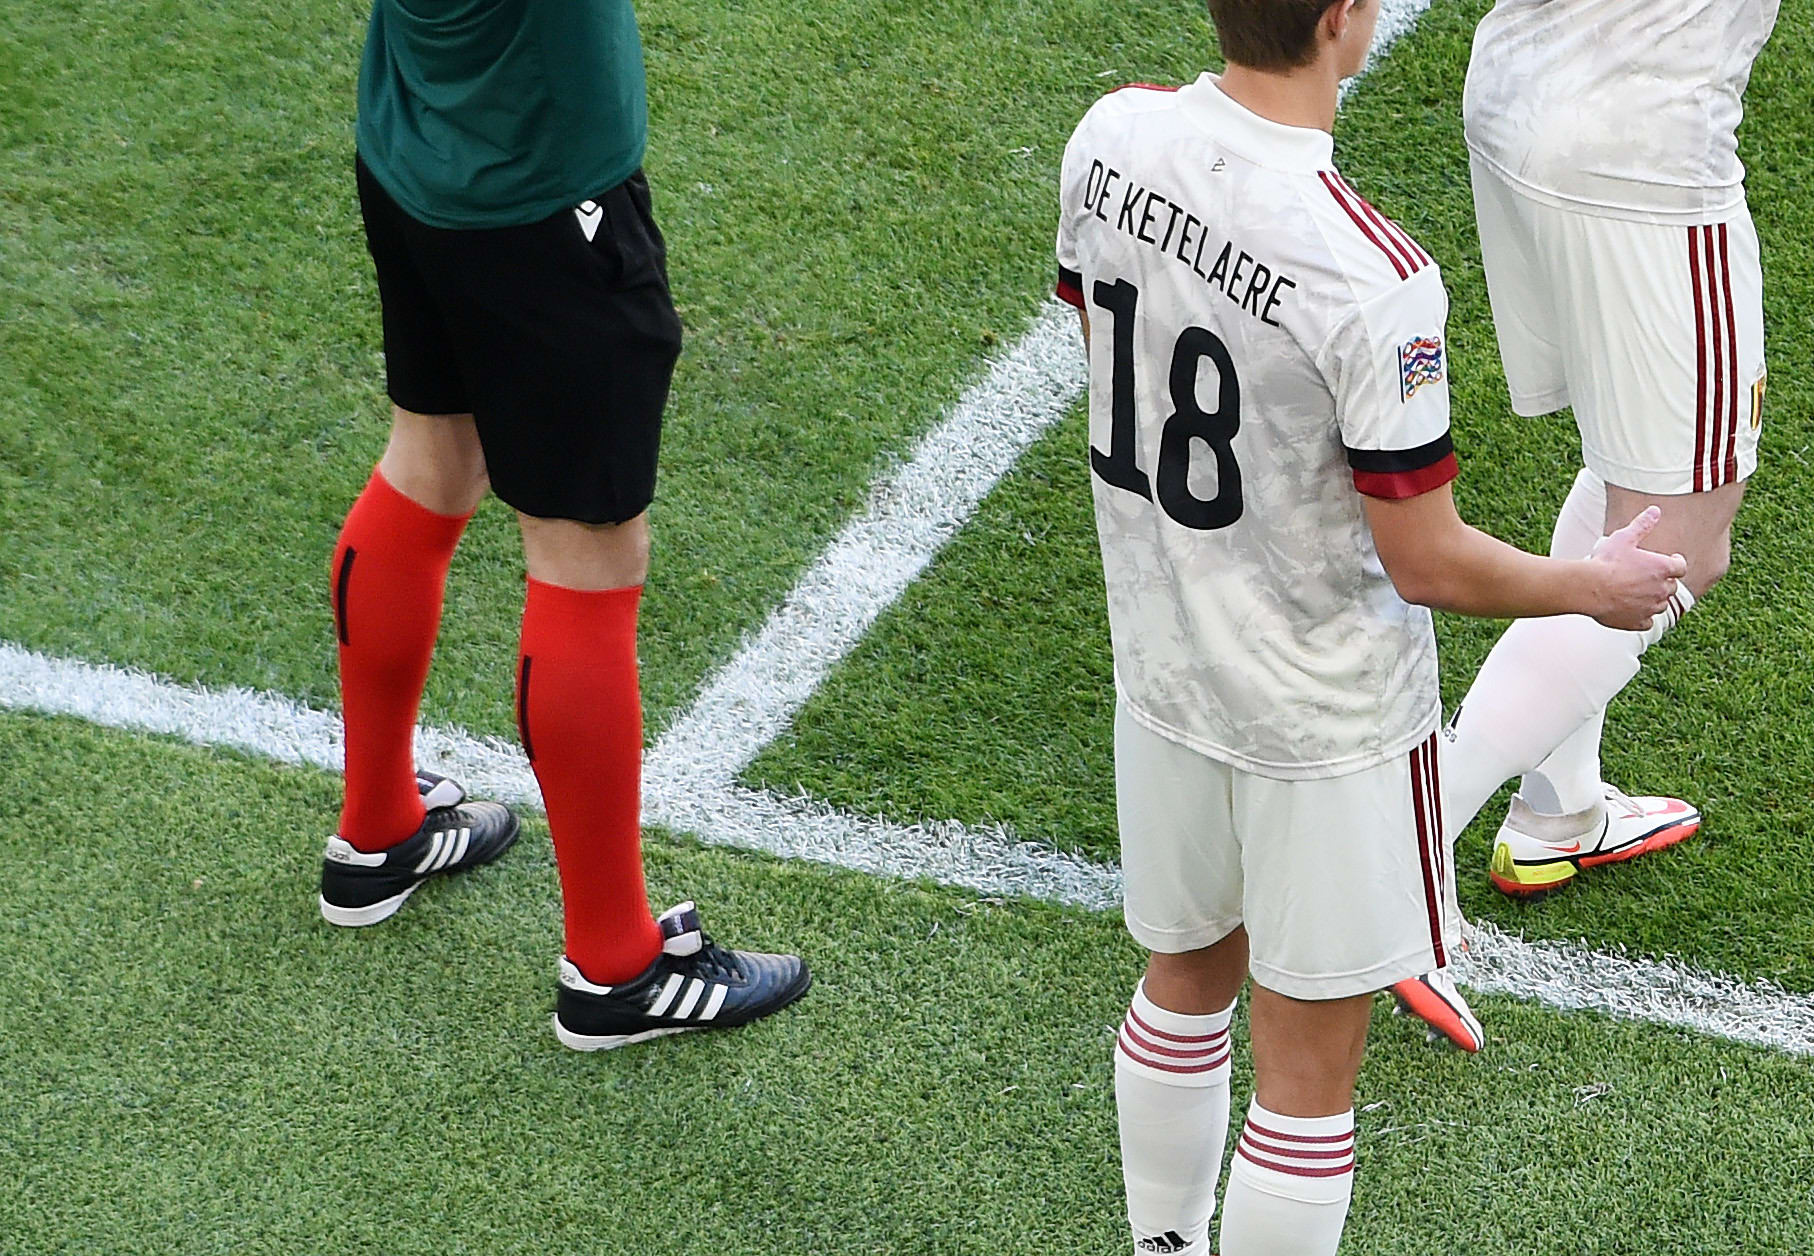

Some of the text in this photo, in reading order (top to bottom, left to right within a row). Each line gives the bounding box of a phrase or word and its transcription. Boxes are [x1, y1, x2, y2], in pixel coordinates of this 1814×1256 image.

[1083, 159, 1296, 327] DE KETELAERE
[1090, 277, 1245, 531] 18
